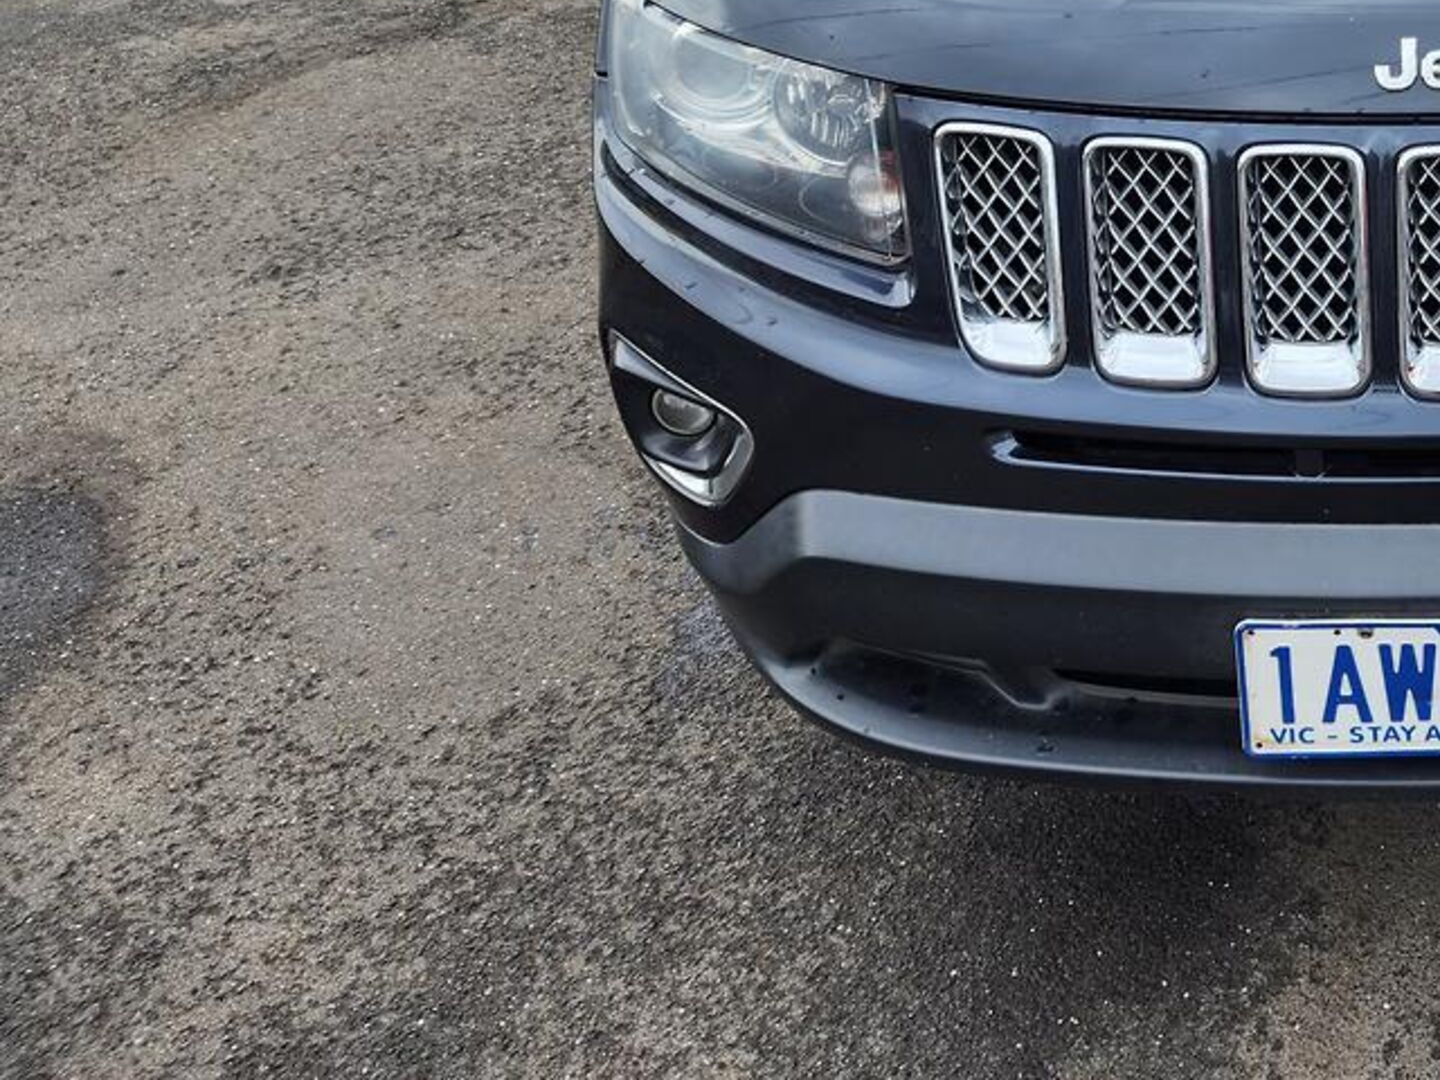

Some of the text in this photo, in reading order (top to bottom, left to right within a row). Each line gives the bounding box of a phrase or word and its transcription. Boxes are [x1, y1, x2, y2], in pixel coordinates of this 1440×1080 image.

[1270, 644, 1436, 724] 1AW
[1270, 727, 1315, 745] VIC
[1350, 725, 1415, 744] STAY
